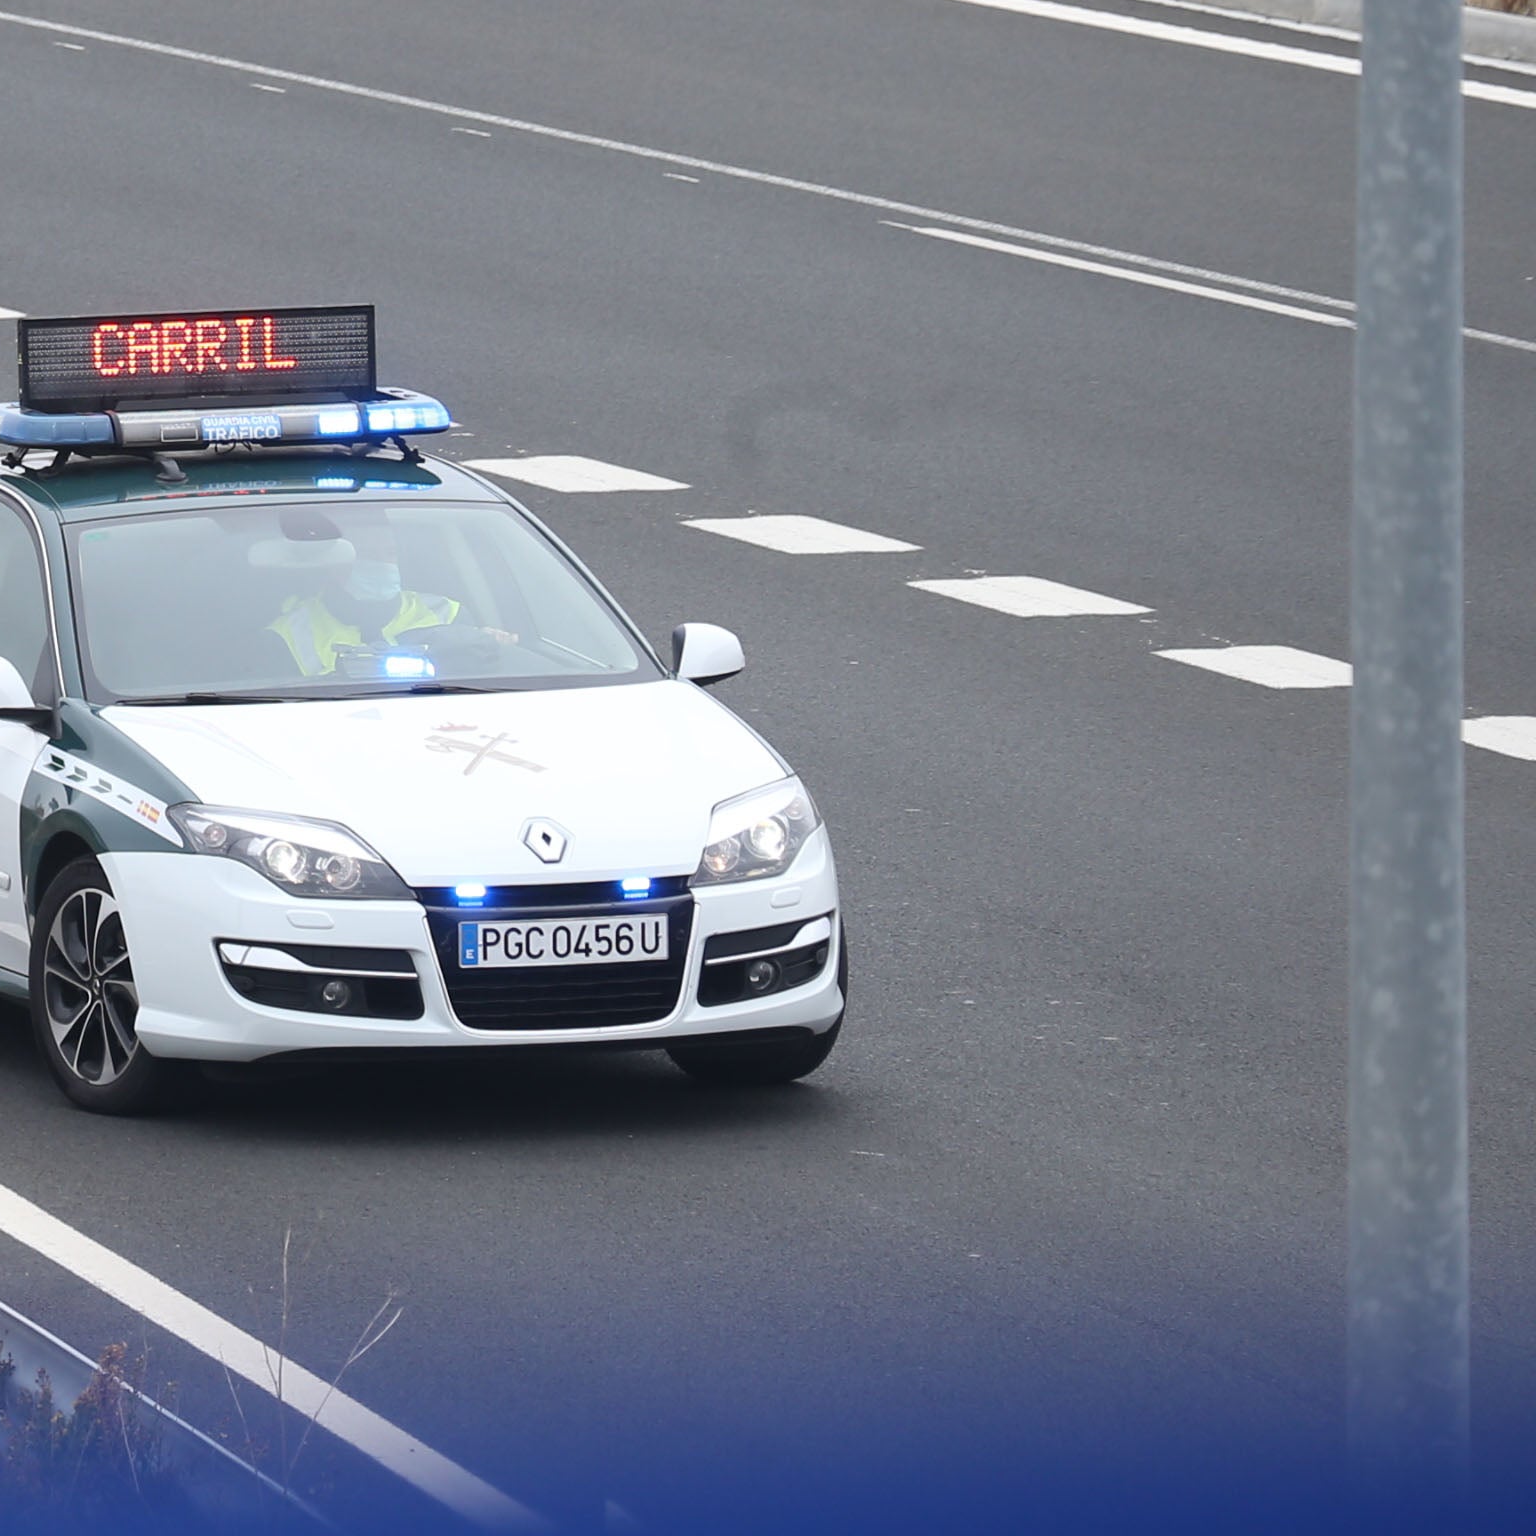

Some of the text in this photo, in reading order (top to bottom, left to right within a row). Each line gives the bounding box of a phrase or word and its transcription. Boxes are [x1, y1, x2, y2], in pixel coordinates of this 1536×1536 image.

[92, 317, 299, 377] CARRIL
[202, 416, 249, 427] GUARDIA
[253, 415, 278, 424] CIVIL
[204, 427, 279, 442] TRAFICO
[482, 921, 660, 961] PGC 0456 U
[465, 948, 475, 959] E
